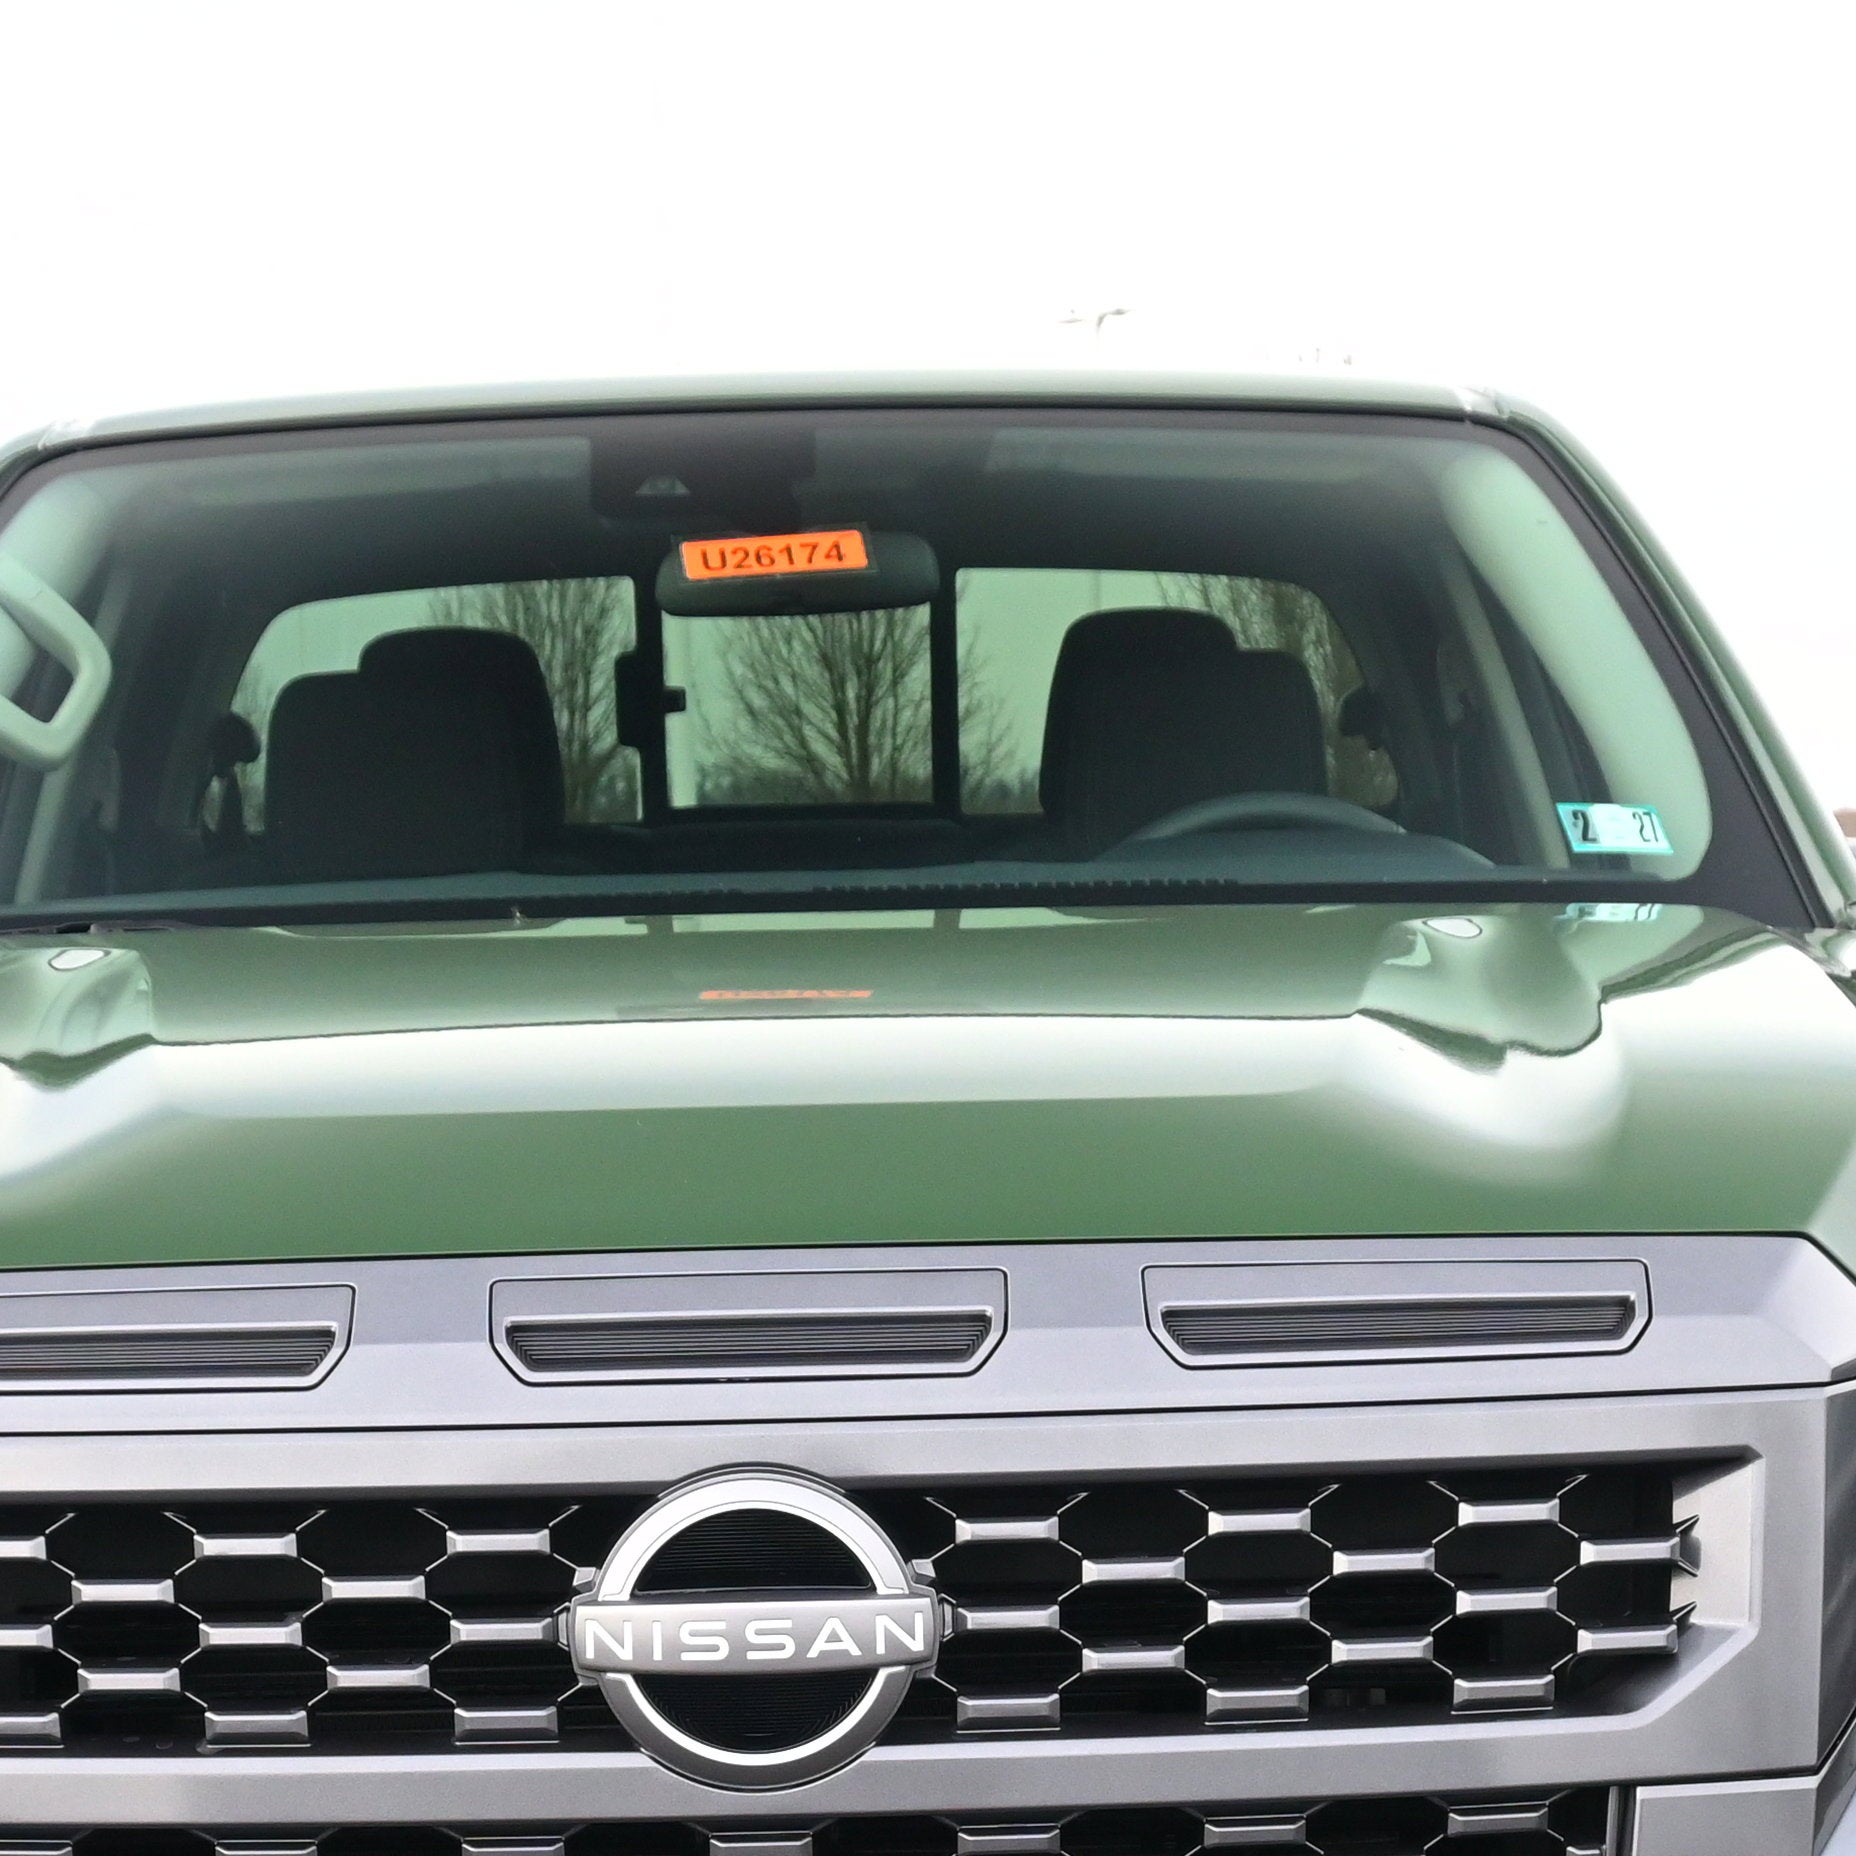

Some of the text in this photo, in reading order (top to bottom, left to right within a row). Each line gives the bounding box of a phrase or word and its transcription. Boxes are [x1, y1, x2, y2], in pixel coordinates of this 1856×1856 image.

[700, 540, 846, 571] U26174
[1571, 809, 1659, 842] 2 27
[584, 1610, 925, 1662] NISSAN
